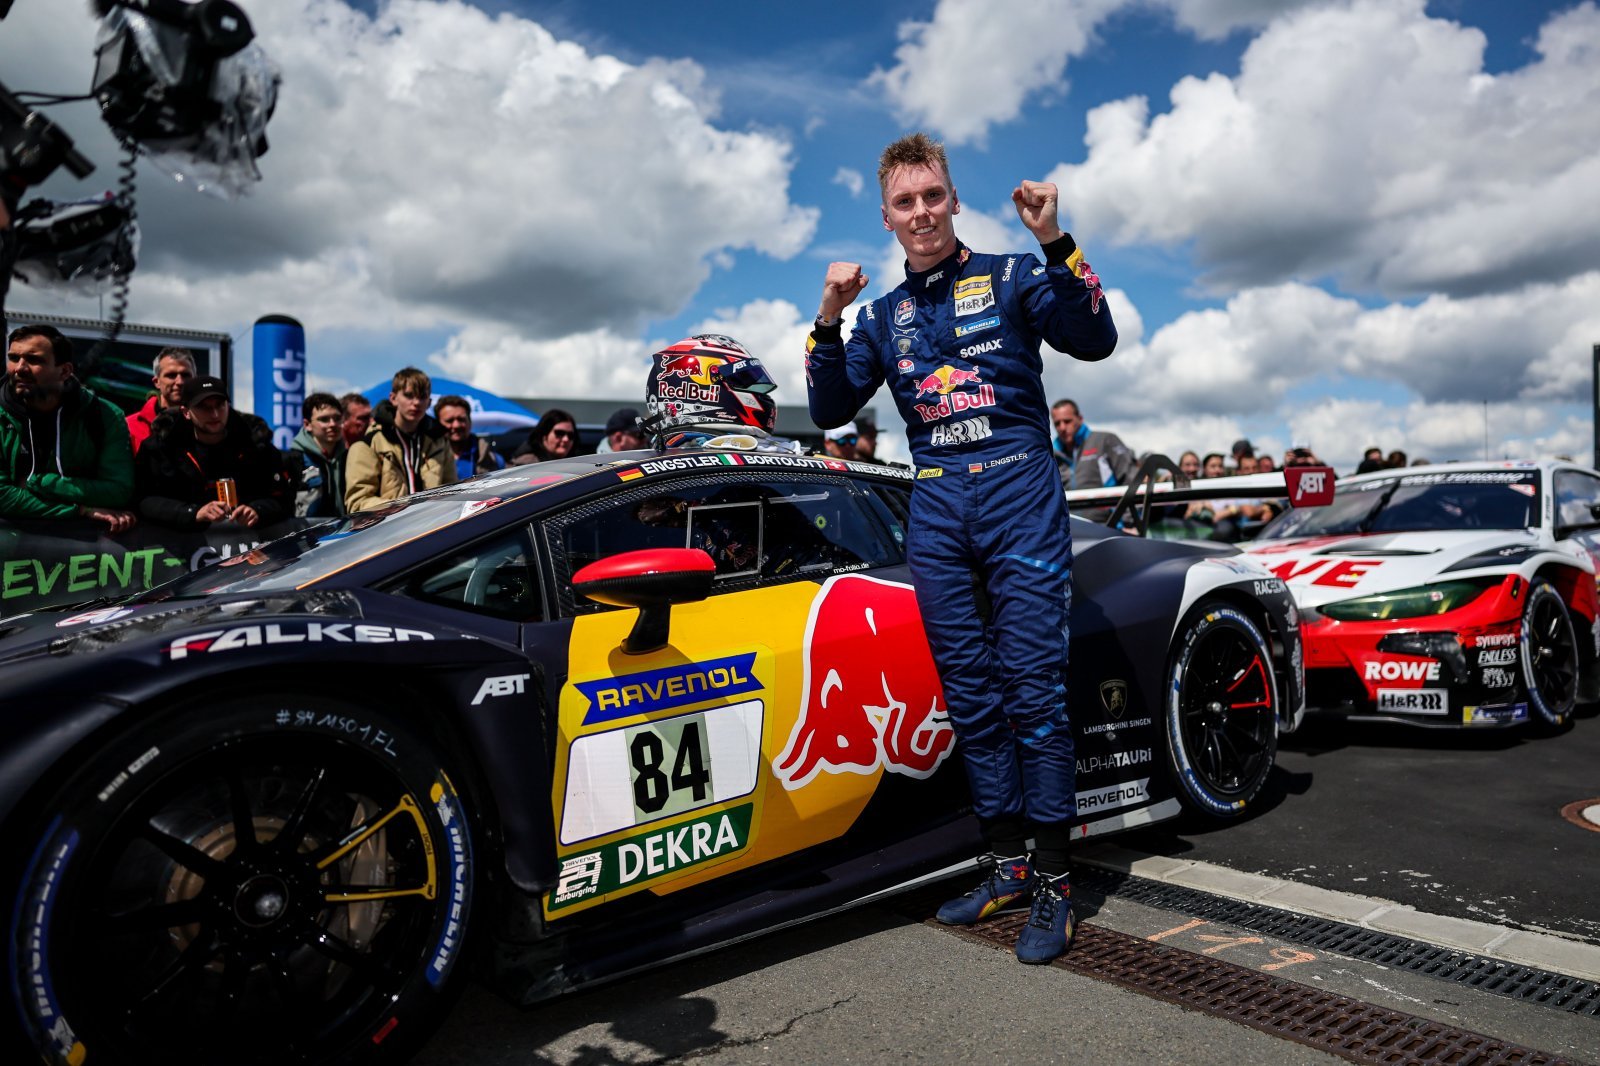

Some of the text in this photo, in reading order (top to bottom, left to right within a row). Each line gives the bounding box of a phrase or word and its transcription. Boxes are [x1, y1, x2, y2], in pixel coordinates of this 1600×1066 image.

[926, 270, 944, 288] ABT
[1002, 257, 1017, 282] Sabelt
[967, 319, 996, 331] MICHELIN
[960, 340, 1003, 359] SONAX
[732, 361, 747, 374] ABT
[658, 381, 721, 403] Red Bull
[914, 384, 997, 423] Red Bull
[640, 456, 722, 474] ENGSTLER
[743, 455, 828, 470] BORTOLOTTI
[1295, 472, 1326, 500] ABT
[162, 622, 436, 661] FALKEN
[1364, 661, 1442, 681] ROWE
[470, 673, 530, 706] ABT
[596, 666, 748, 711] RAVENOL
[1381, 694, 1418, 708] H&R
[1083, 717, 1152, 735] LAMBORGHINI SINGEN
[630, 721, 710, 814] 84
[1077, 786, 1144, 810] RAVENOL
[618, 814, 739, 885] DEKRA
[554, 885, 598, 905] nürburgring
